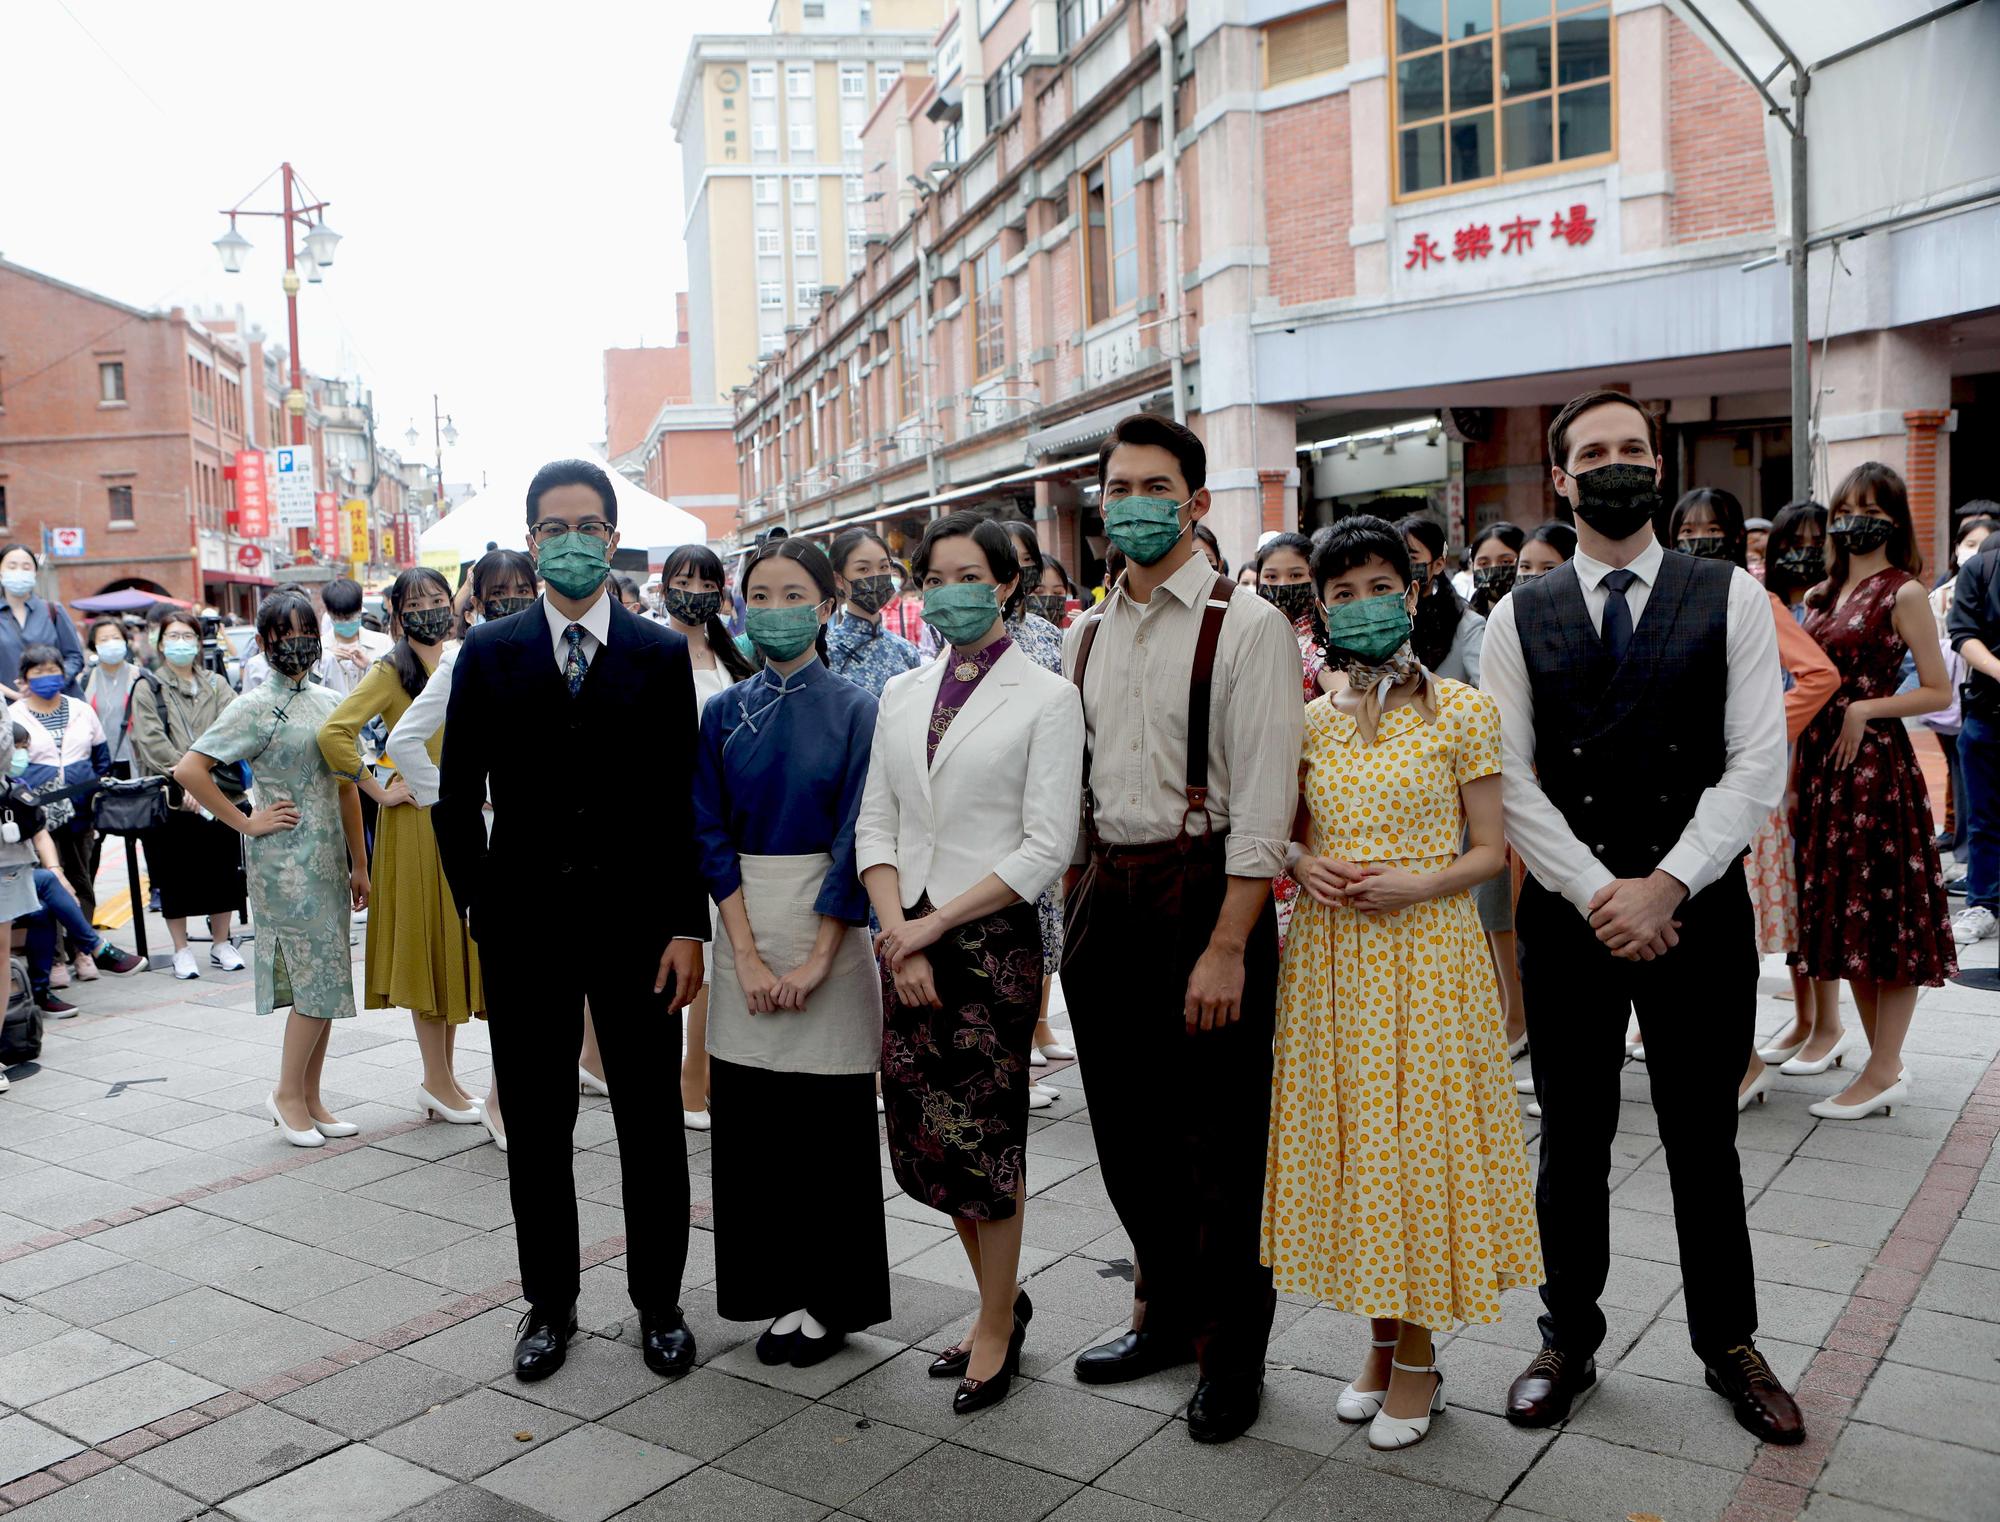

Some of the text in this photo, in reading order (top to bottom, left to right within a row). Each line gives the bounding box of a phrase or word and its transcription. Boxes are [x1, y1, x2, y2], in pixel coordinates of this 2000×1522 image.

[1404, 204, 1597, 270] 永樂市場
[280, 452, 291, 471] P
